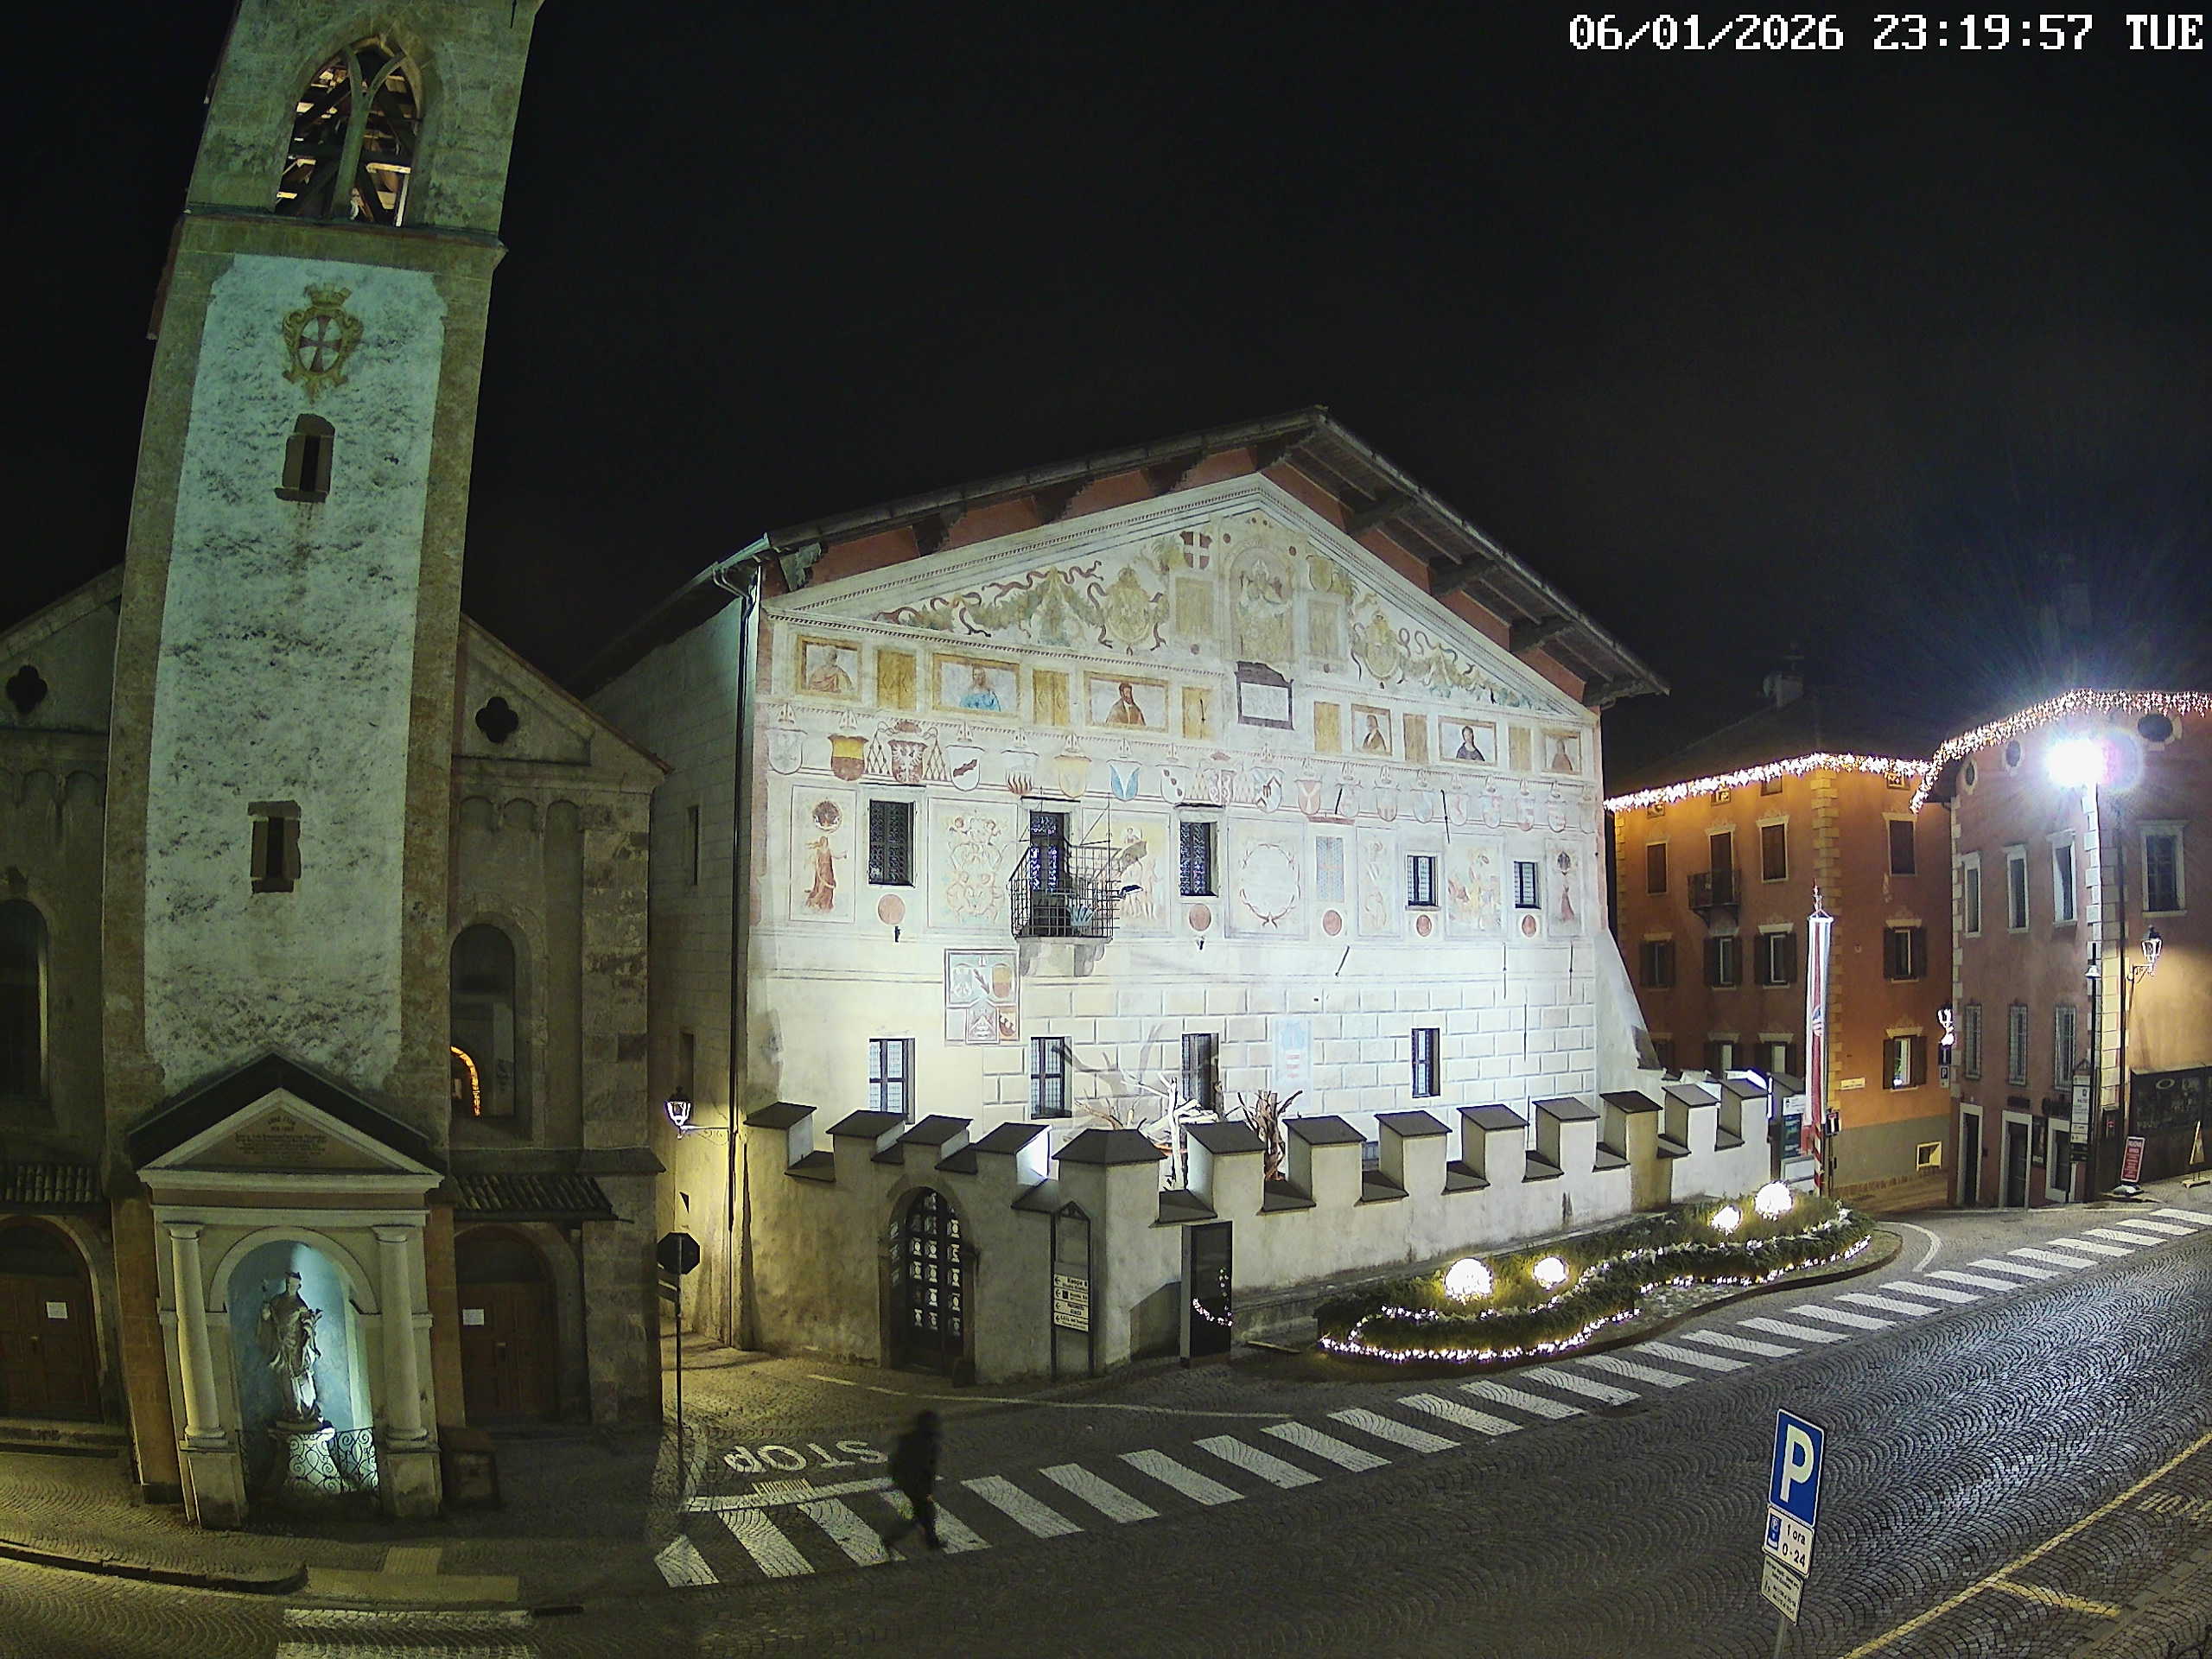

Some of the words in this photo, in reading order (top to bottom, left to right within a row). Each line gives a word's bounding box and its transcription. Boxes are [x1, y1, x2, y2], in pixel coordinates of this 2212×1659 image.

[723, 1440, 888, 1472] STOP
[1780, 1423, 1814, 1503] P
[1787, 1523, 1791, 1536] 1
[1792, 1530, 1806, 1546] ora
